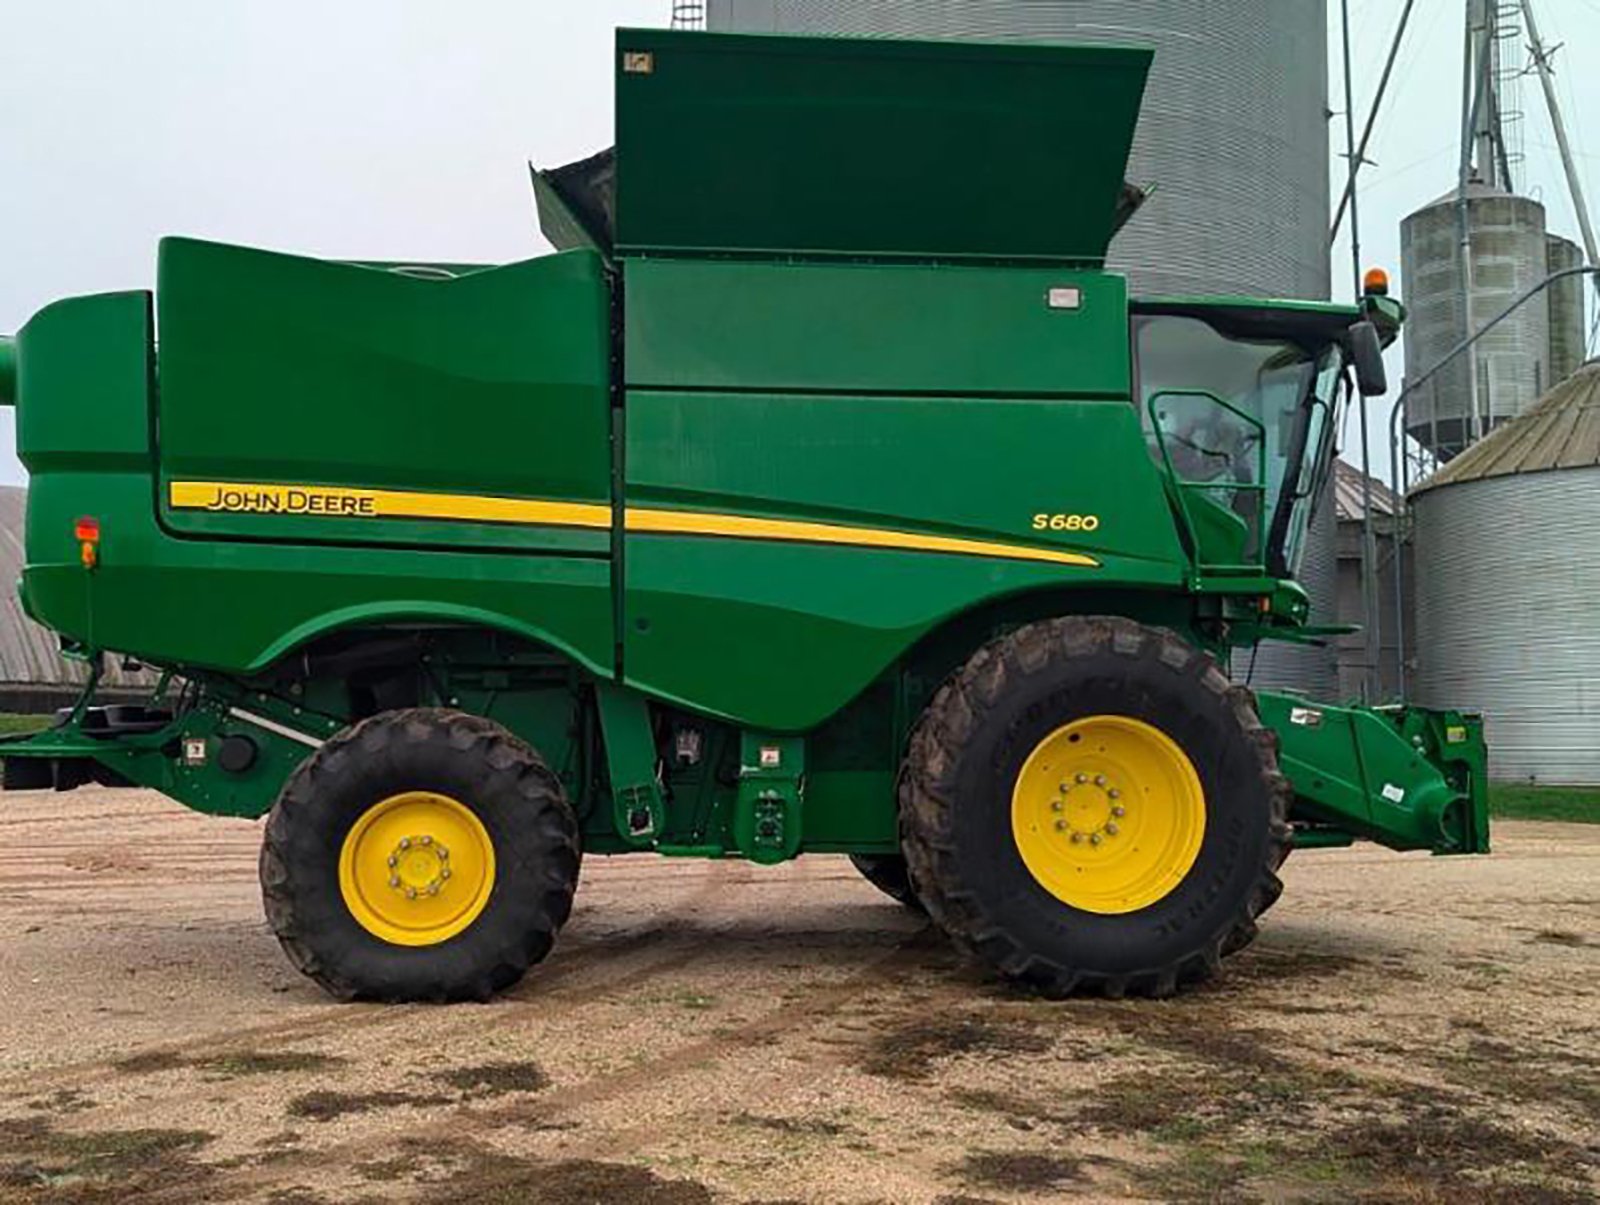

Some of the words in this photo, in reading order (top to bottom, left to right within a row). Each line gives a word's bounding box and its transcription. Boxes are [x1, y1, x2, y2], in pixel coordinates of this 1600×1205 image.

[207, 487, 280, 511] JOHN
[287, 490, 376, 515] DEERE
[1032, 513, 1098, 531] S680
